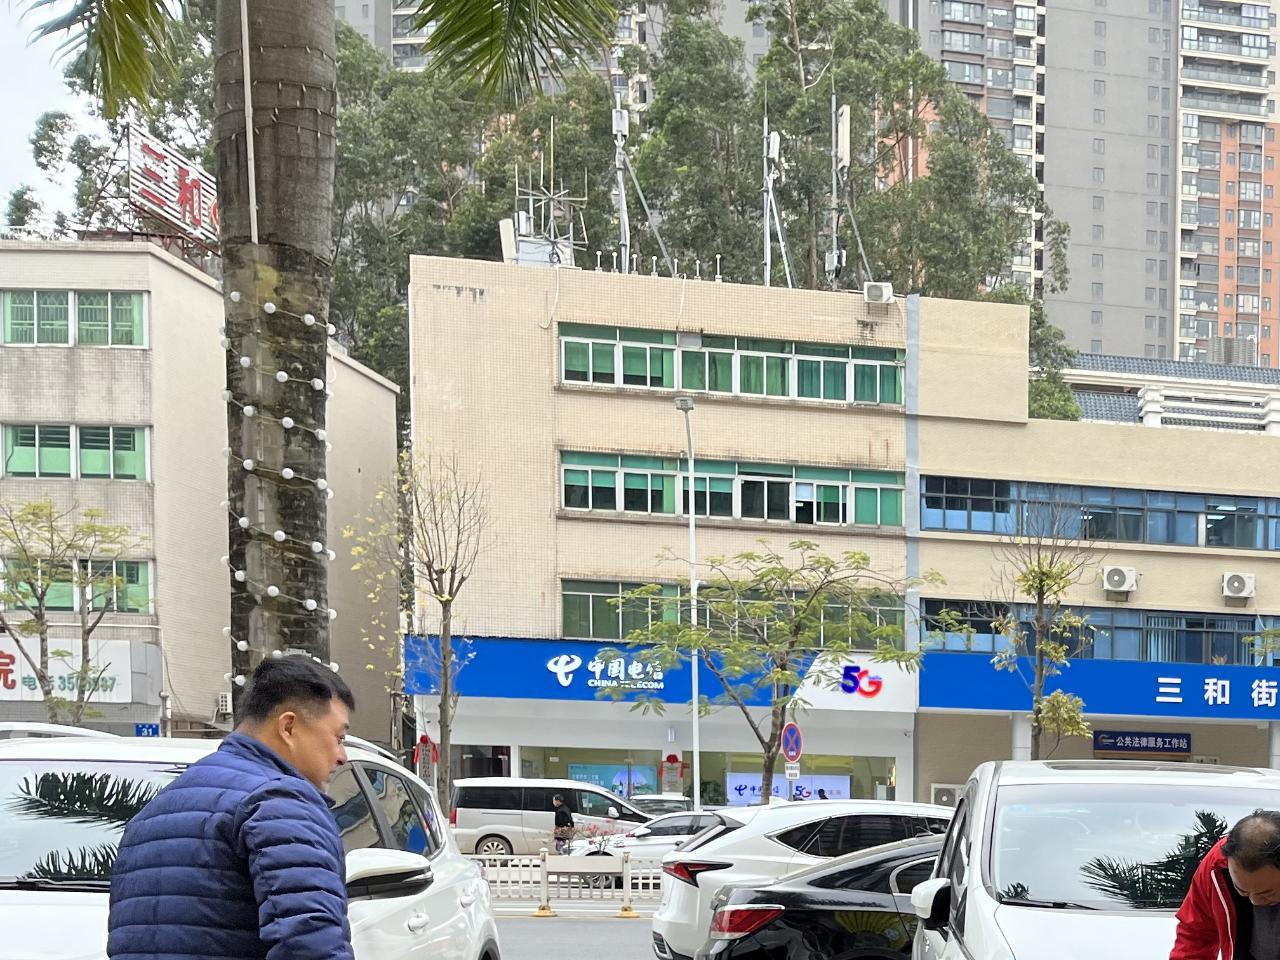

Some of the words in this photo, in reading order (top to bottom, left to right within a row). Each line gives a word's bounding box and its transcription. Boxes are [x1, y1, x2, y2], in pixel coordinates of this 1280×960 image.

[139, 143, 202, 227] 三和
[587, 658, 664, 680] 中国电信
[587, 679, 618, 688] CHINA
[840, 665, 883, 698] 5G
[1116, 736, 1188, 749] 公共法律服务工作站
[795, 785, 812, 798] 5G
